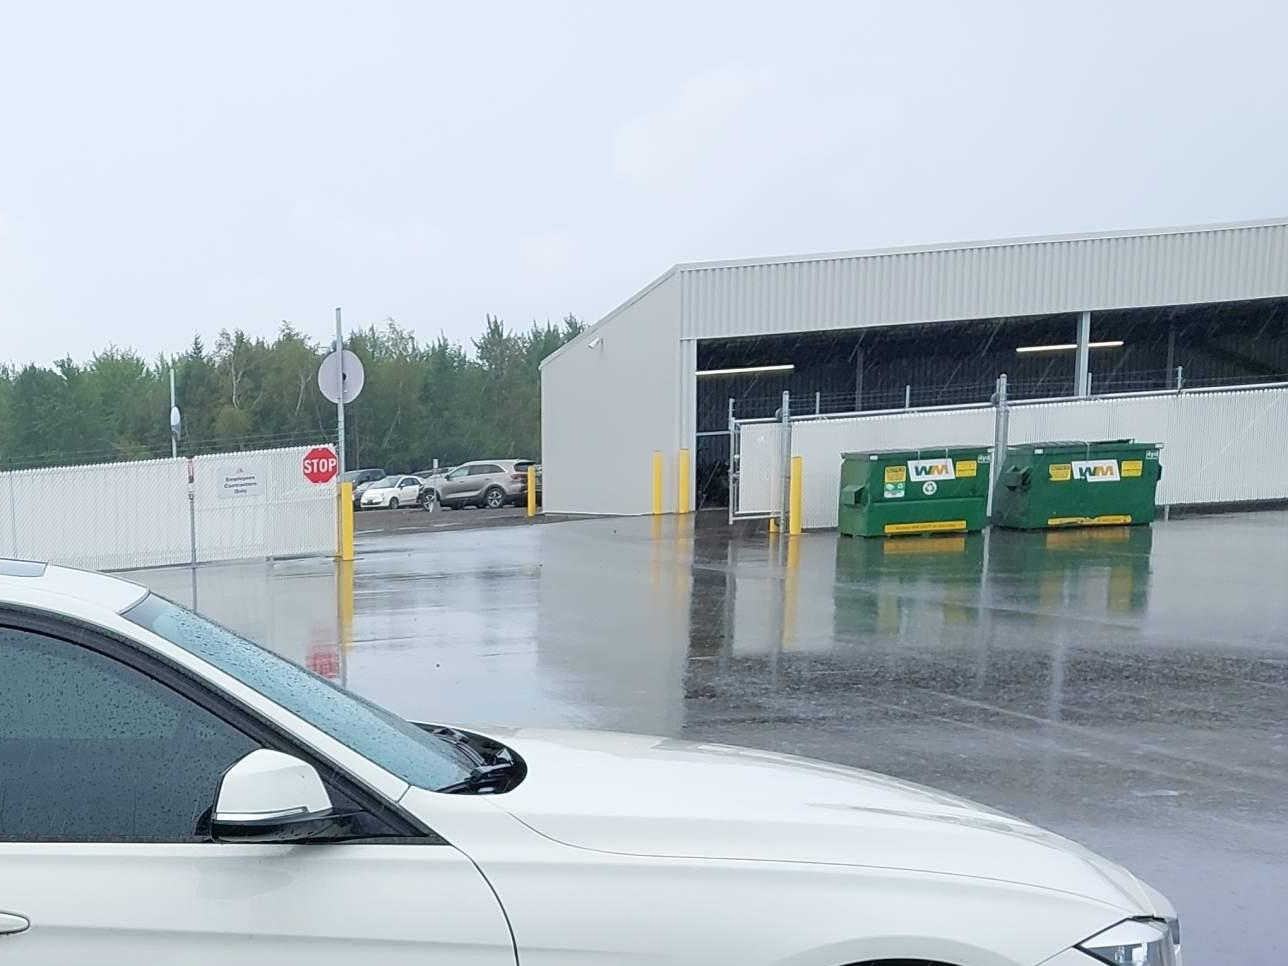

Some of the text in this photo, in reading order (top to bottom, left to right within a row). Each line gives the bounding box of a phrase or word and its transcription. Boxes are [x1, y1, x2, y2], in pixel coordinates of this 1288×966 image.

[303, 458, 337, 474] STOP
[914, 464, 949, 476] WM
[1078, 465, 1114, 477] WM
